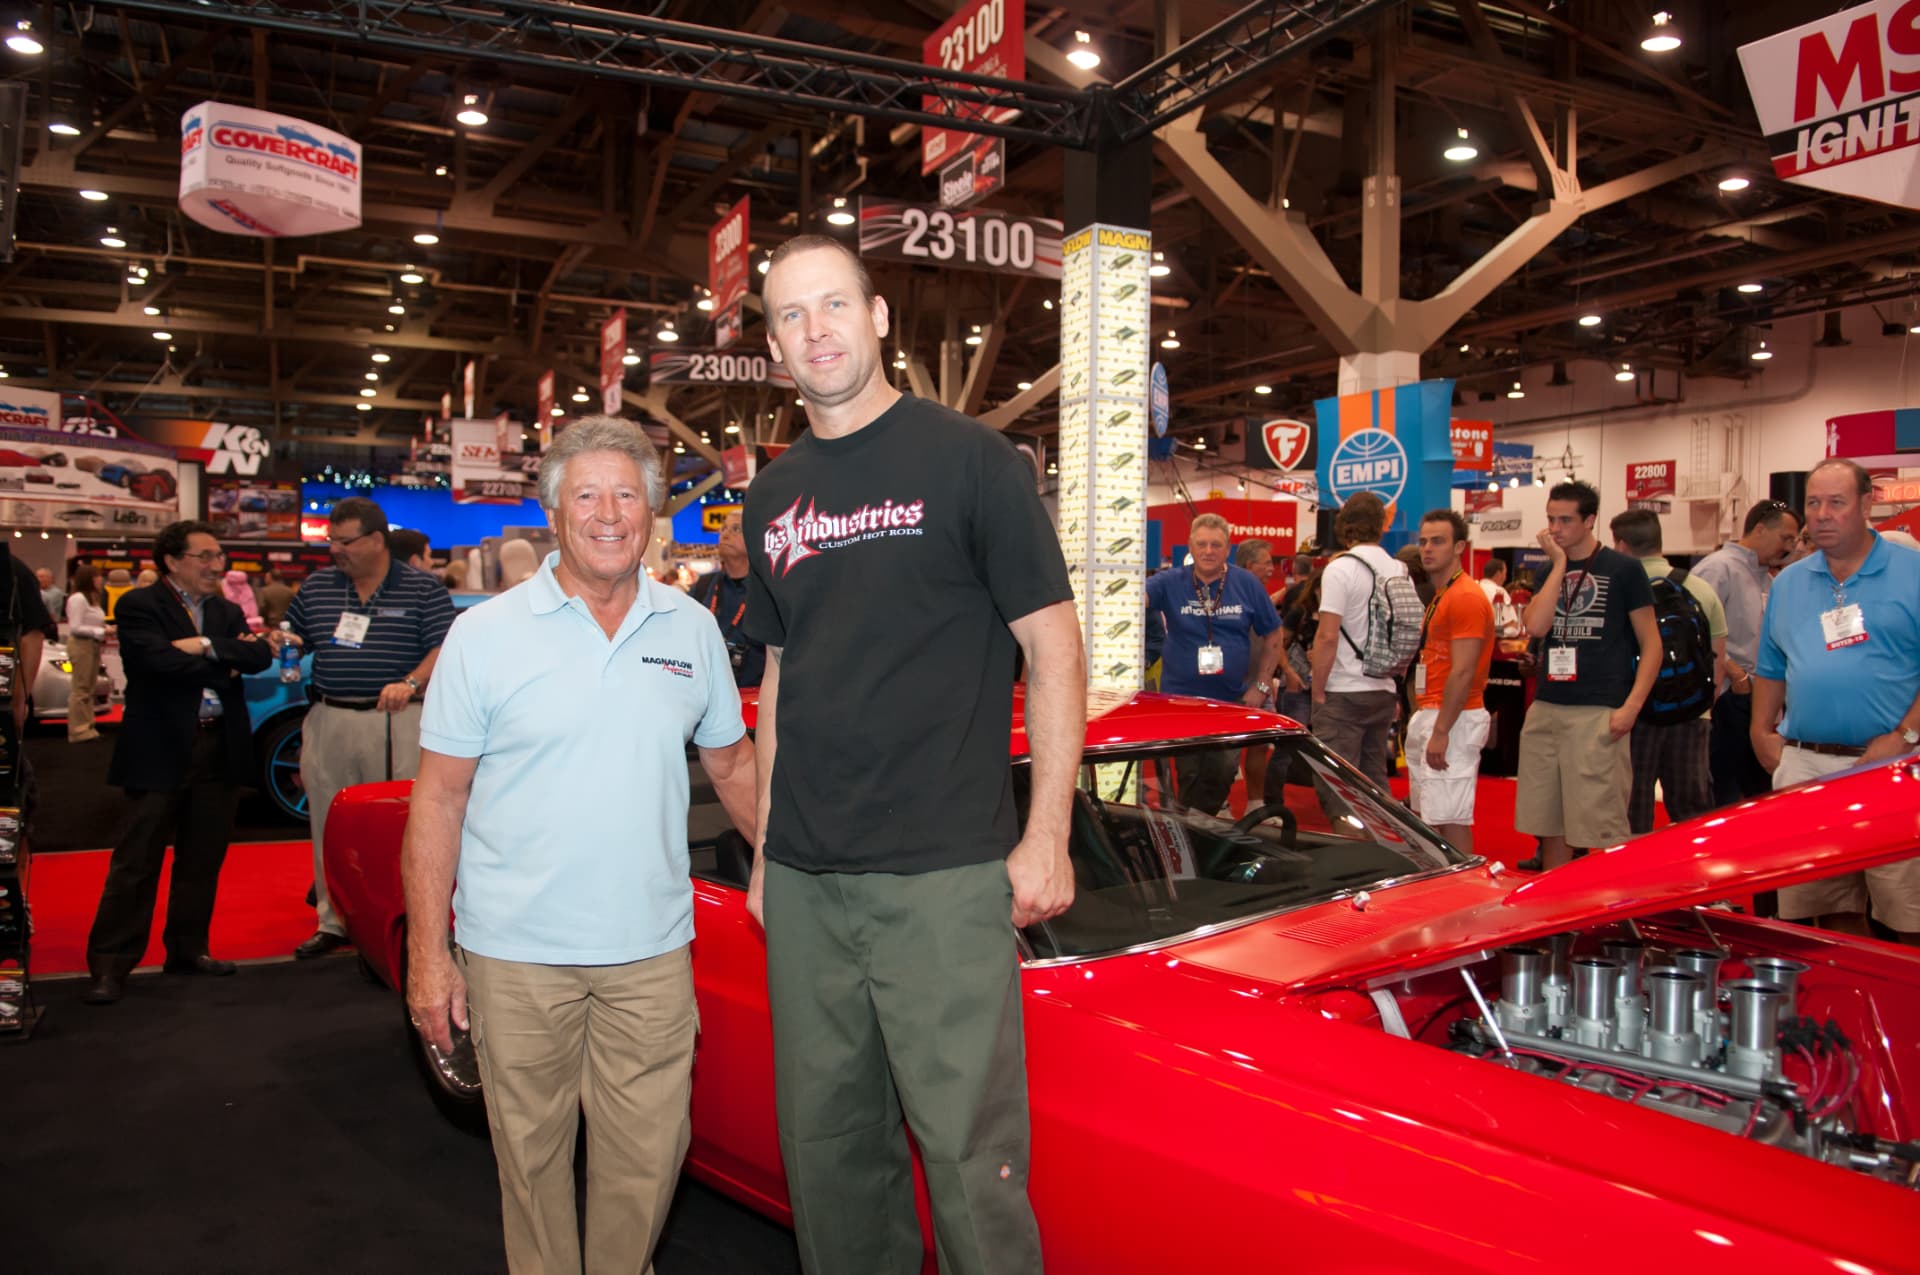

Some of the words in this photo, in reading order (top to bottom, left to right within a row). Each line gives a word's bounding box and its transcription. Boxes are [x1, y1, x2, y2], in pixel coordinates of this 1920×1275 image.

[940, 0, 1005, 73] 23100
[214, 127, 358, 180] COVERCRAFT
[225, 155, 262, 169] Quality
[902, 208, 1034, 269] 23100
[1098, 228, 1151, 250] MAGN
[688, 354, 768, 382] 23000
[1336, 458, 1400, 485] EMPI
[818, 535, 860, 549] CUSTOM
[863, 529, 887, 540] HOT
[889, 528, 923, 537] RODS
[641, 656, 692, 669] MAGNAFLOW
